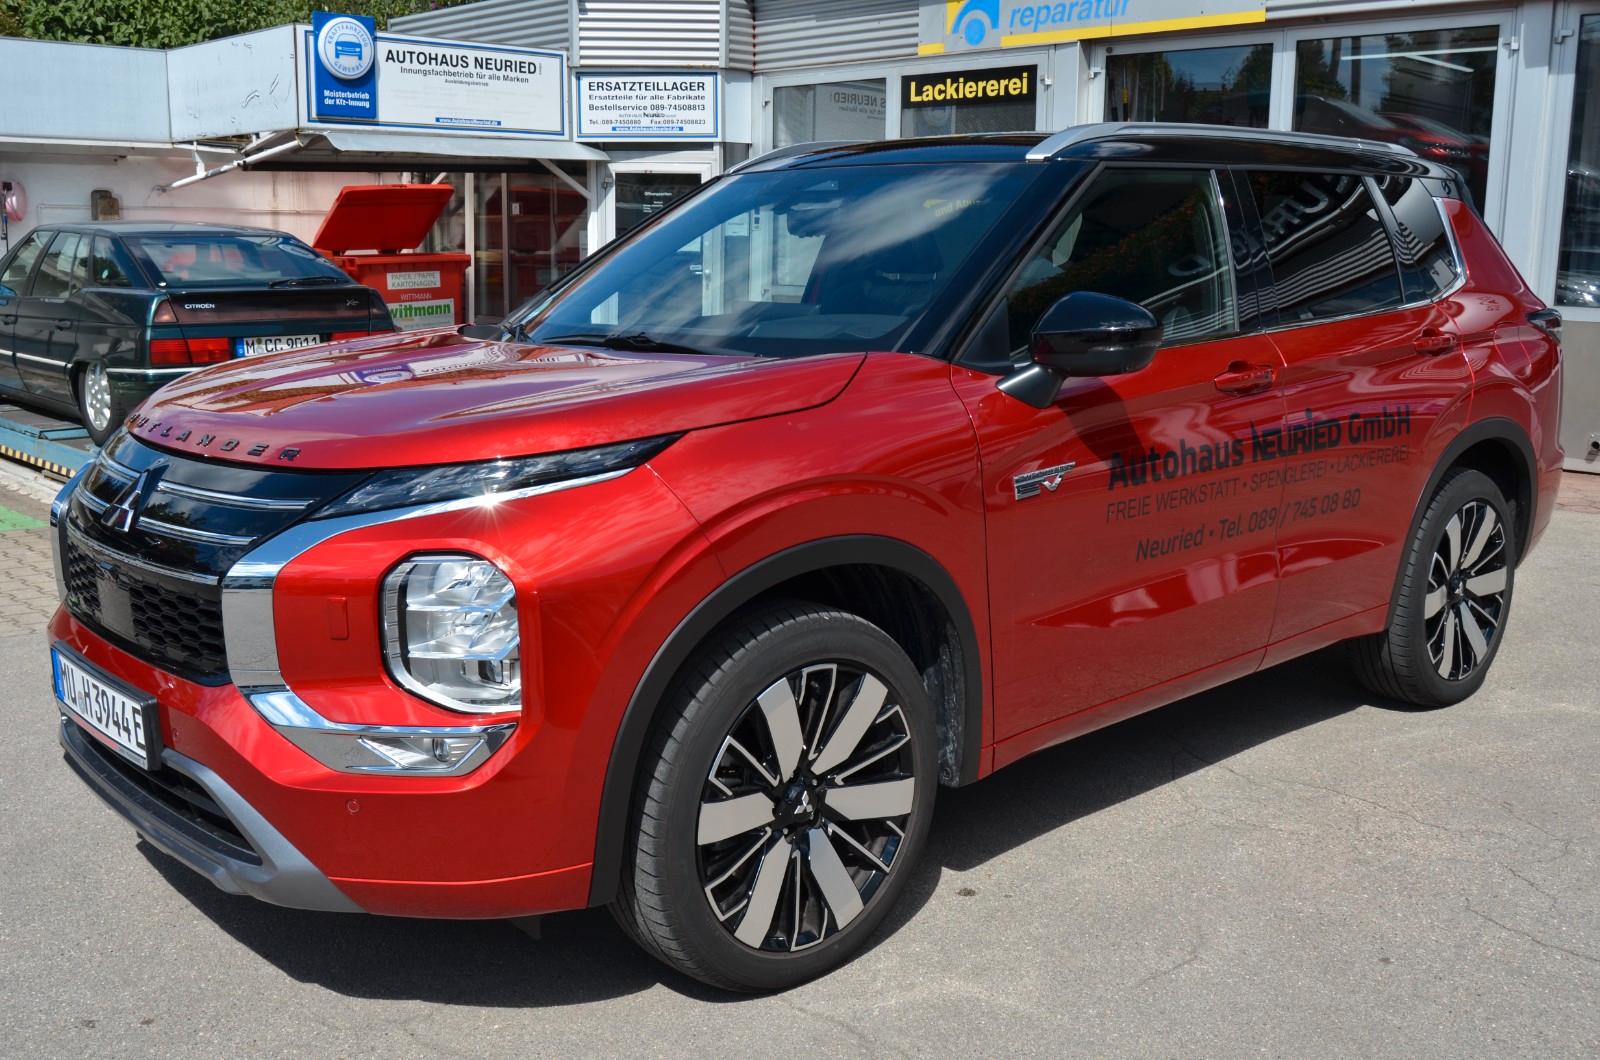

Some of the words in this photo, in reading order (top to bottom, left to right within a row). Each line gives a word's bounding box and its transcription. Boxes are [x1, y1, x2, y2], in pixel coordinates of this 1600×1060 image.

[1009, 0, 1130, 32] reparatur
[385, 49, 469, 68] AUTOHAUS
[474, 56, 537, 75] NEURIED
[400, 66, 474, 79] Innungsfachbetrieb
[502, 74, 529, 84] Marken
[588, 81, 705, 91] ERSATZTEILLAGER
[323, 89, 370, 99] Meisterbetrieb
[910, 72, 1028, 102] Lackiererei
[324, 97, 335, 105] der
[588, 103, 648, 111] Bestellservice
[245, 339, 255, 354] M
[1107, 437, 1244, 491] Autohaus
[1348, 405, 1411, 444] GmbH
[1106, 495, 1152, 523] FREIE
[1156, 477, 1240, 512] WERKSTATT
[1250, 460, 1328, 492] SPENGLEREI
[1337, 444, 1410, 474] LACKIEREREI
[1136, 523, 1206, 562] Neuried
[1219, 513, 1243, 539] Tel.
